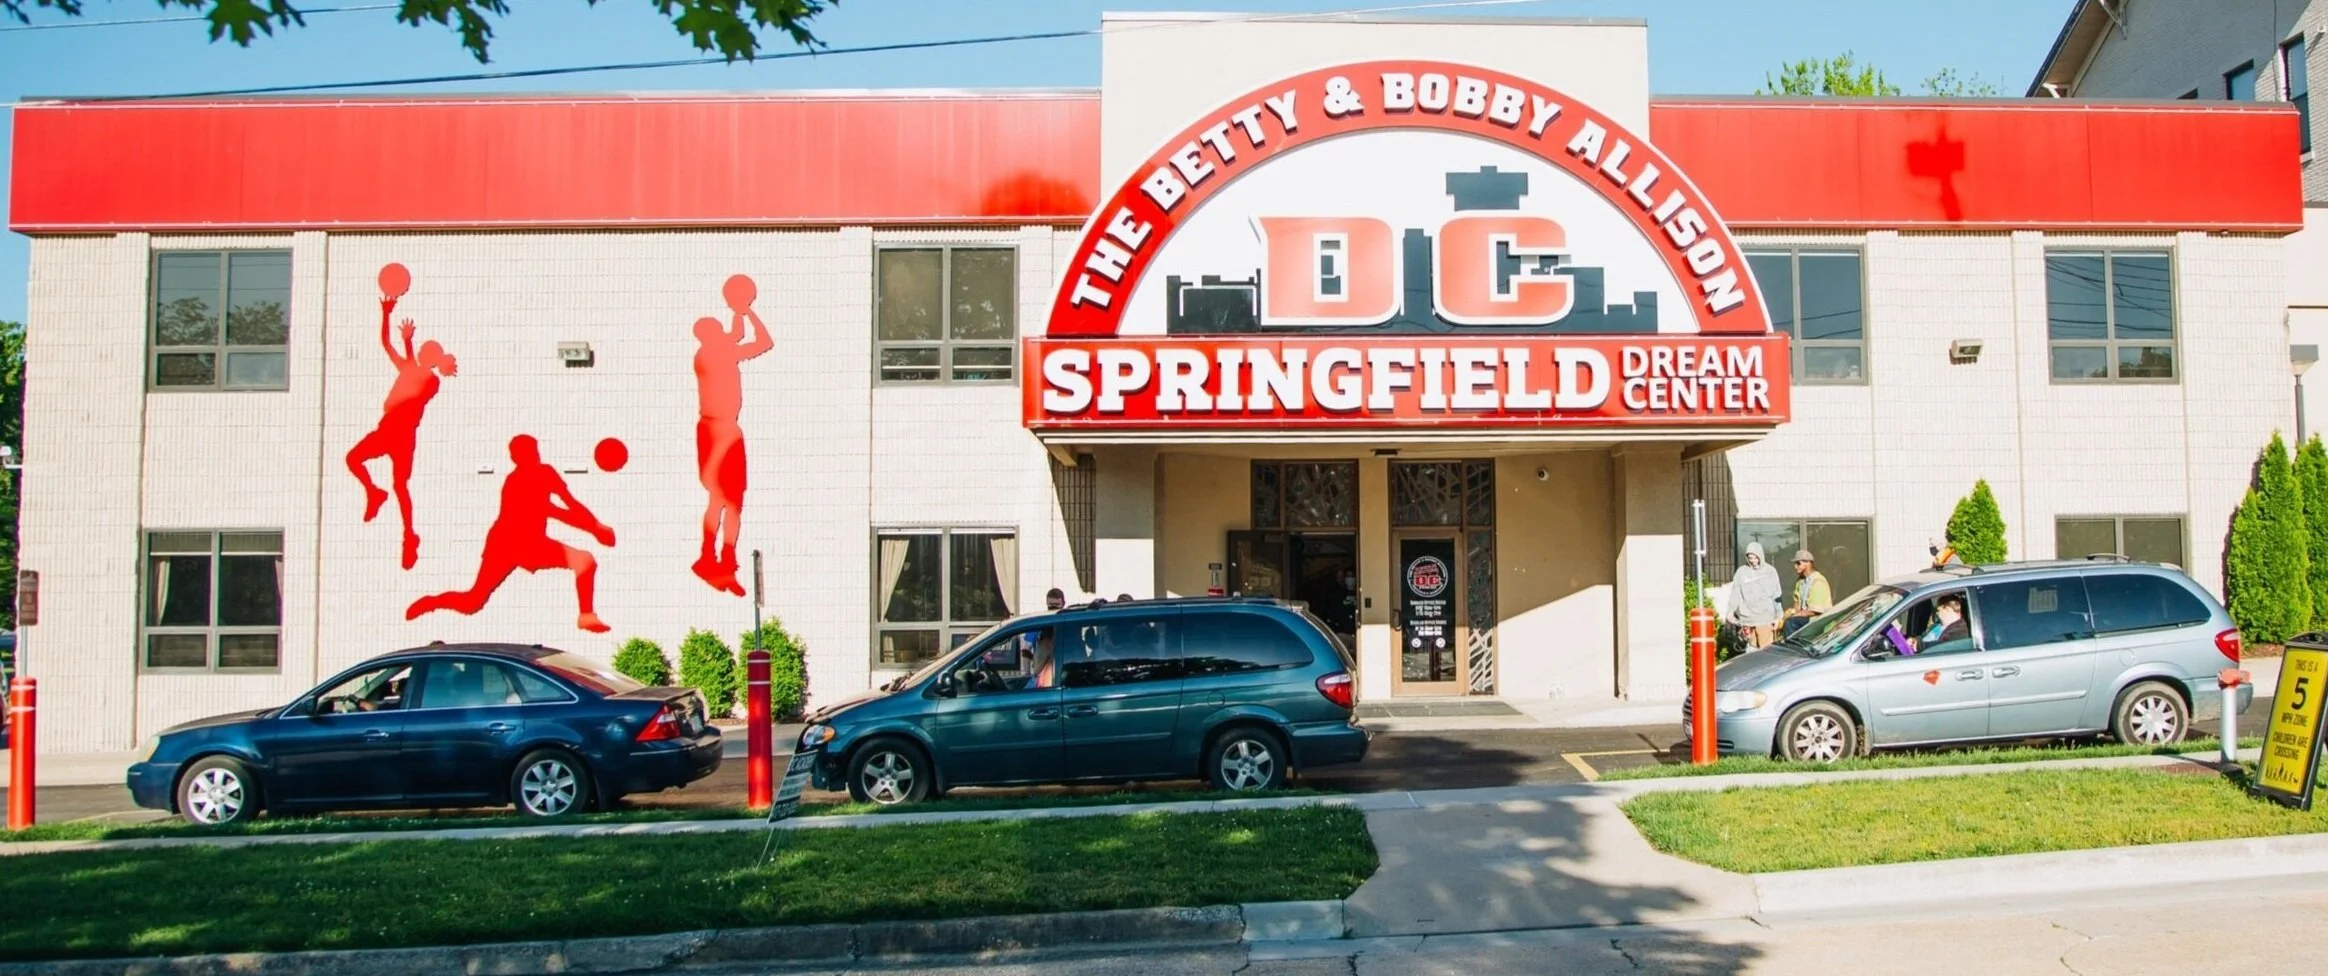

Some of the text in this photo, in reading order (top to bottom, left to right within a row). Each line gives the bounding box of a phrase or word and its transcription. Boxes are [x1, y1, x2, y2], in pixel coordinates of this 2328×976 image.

[1070, 72, 1746, 315] THE BETTY & BOBBY ALLISON
[1258, 215, 1575, 326] DC
[1621, 345, 1764, 377] DREAM
[1042, 347, 1612, 414] SPRINGFIELD
[1622, 376, 1770, 410] CENTER
[2291, 677, 2309, 710] 5
[2272, 731, 2297, 746] CHILDREN
[2273, 745, 2300, 760] CROSSING
